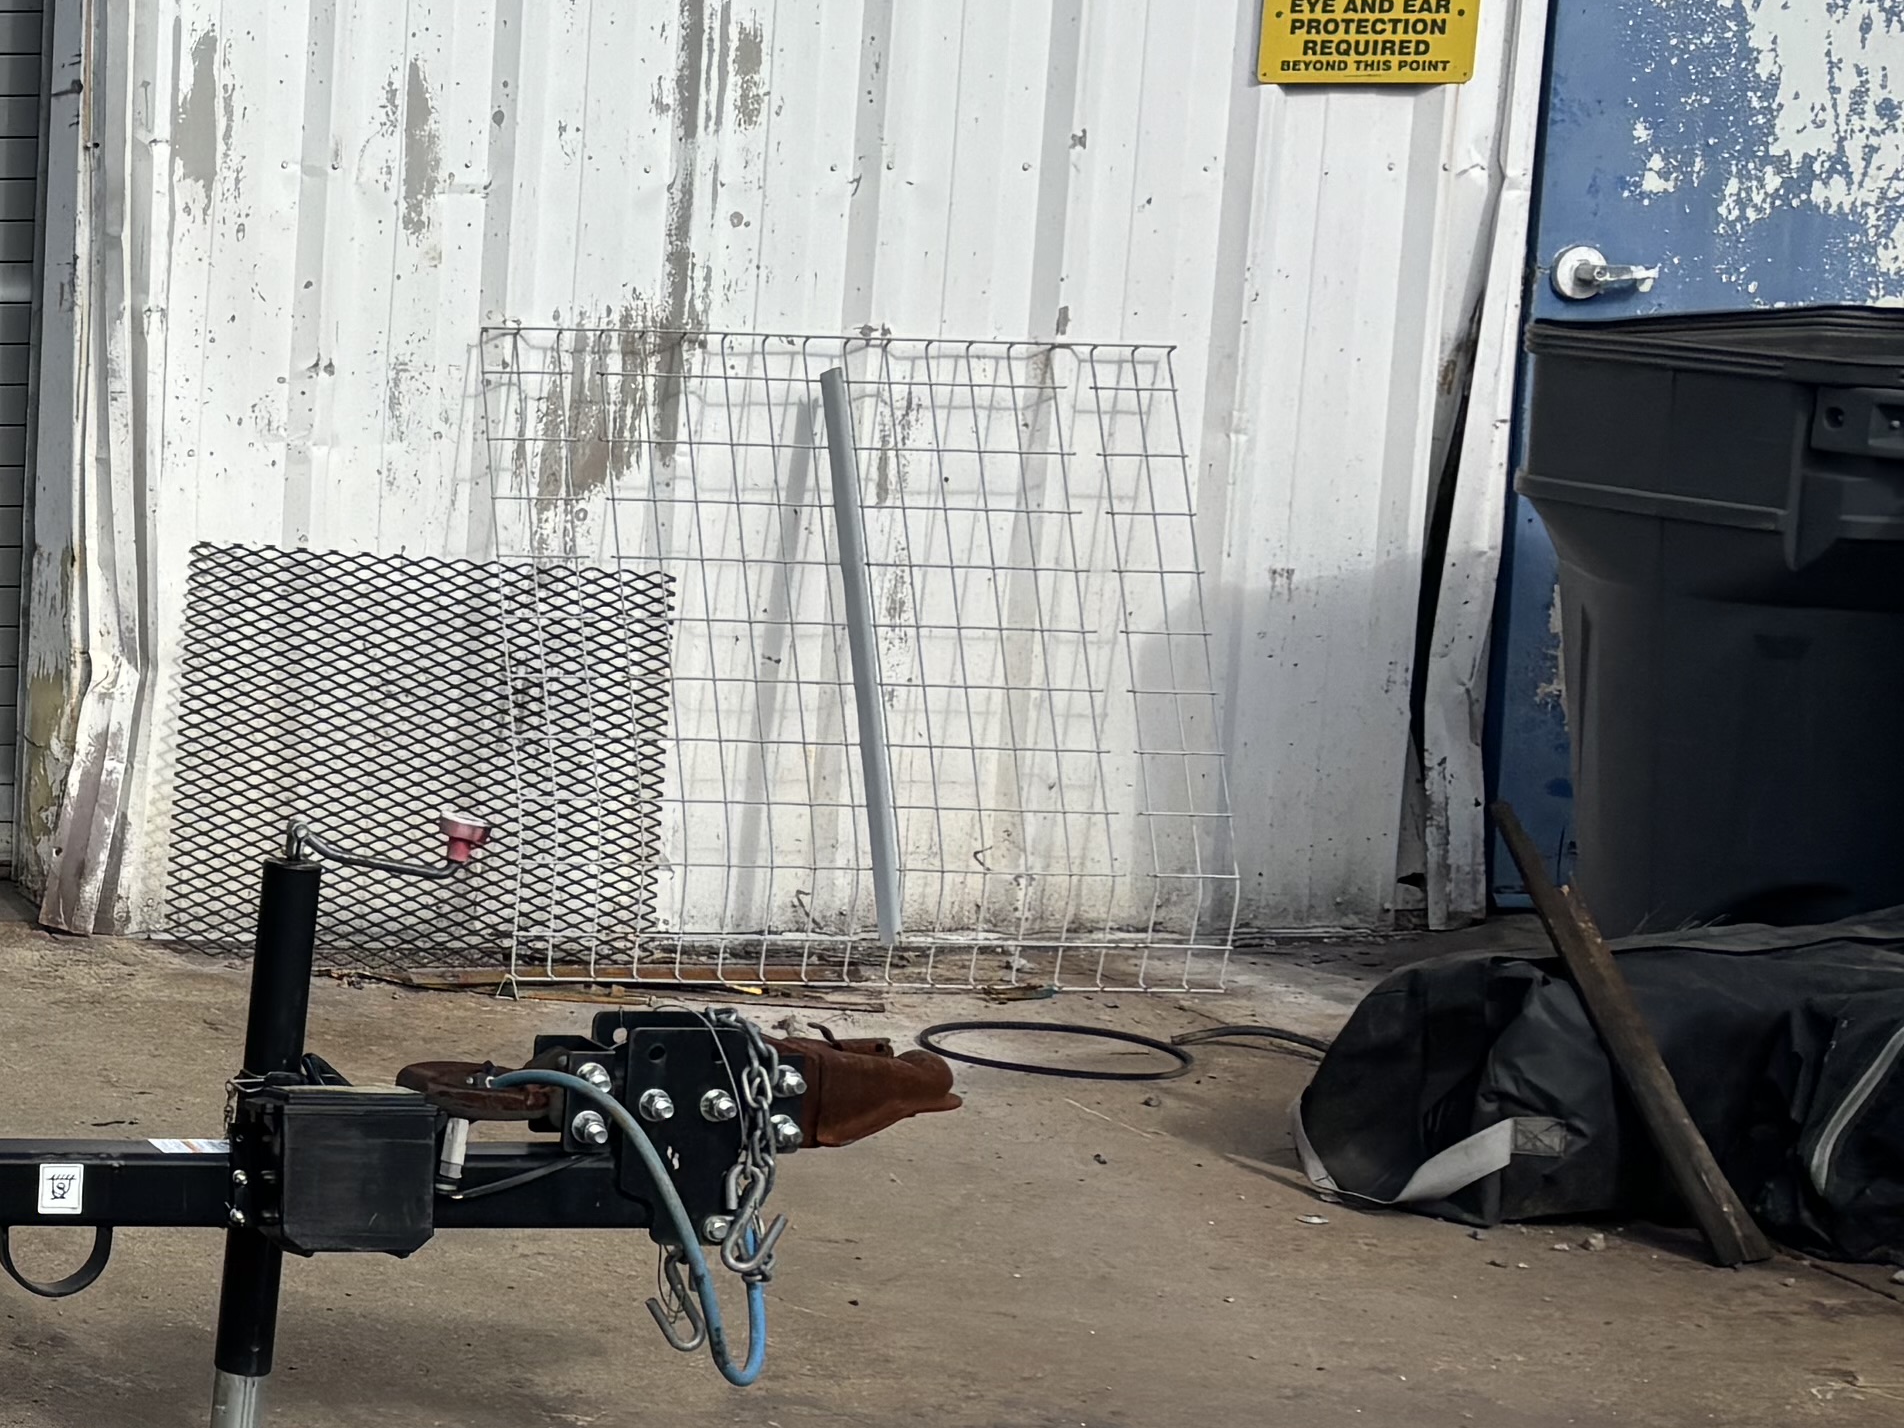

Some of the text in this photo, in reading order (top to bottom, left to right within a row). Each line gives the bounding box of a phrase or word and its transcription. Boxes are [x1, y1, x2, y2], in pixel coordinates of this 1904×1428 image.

[1290, 19, 1447, 35] PROTECTION
[1303, 39, 1430, 57] REQUIRED
[1280, 60, 1451, 71] BEYOND THIS POINT
